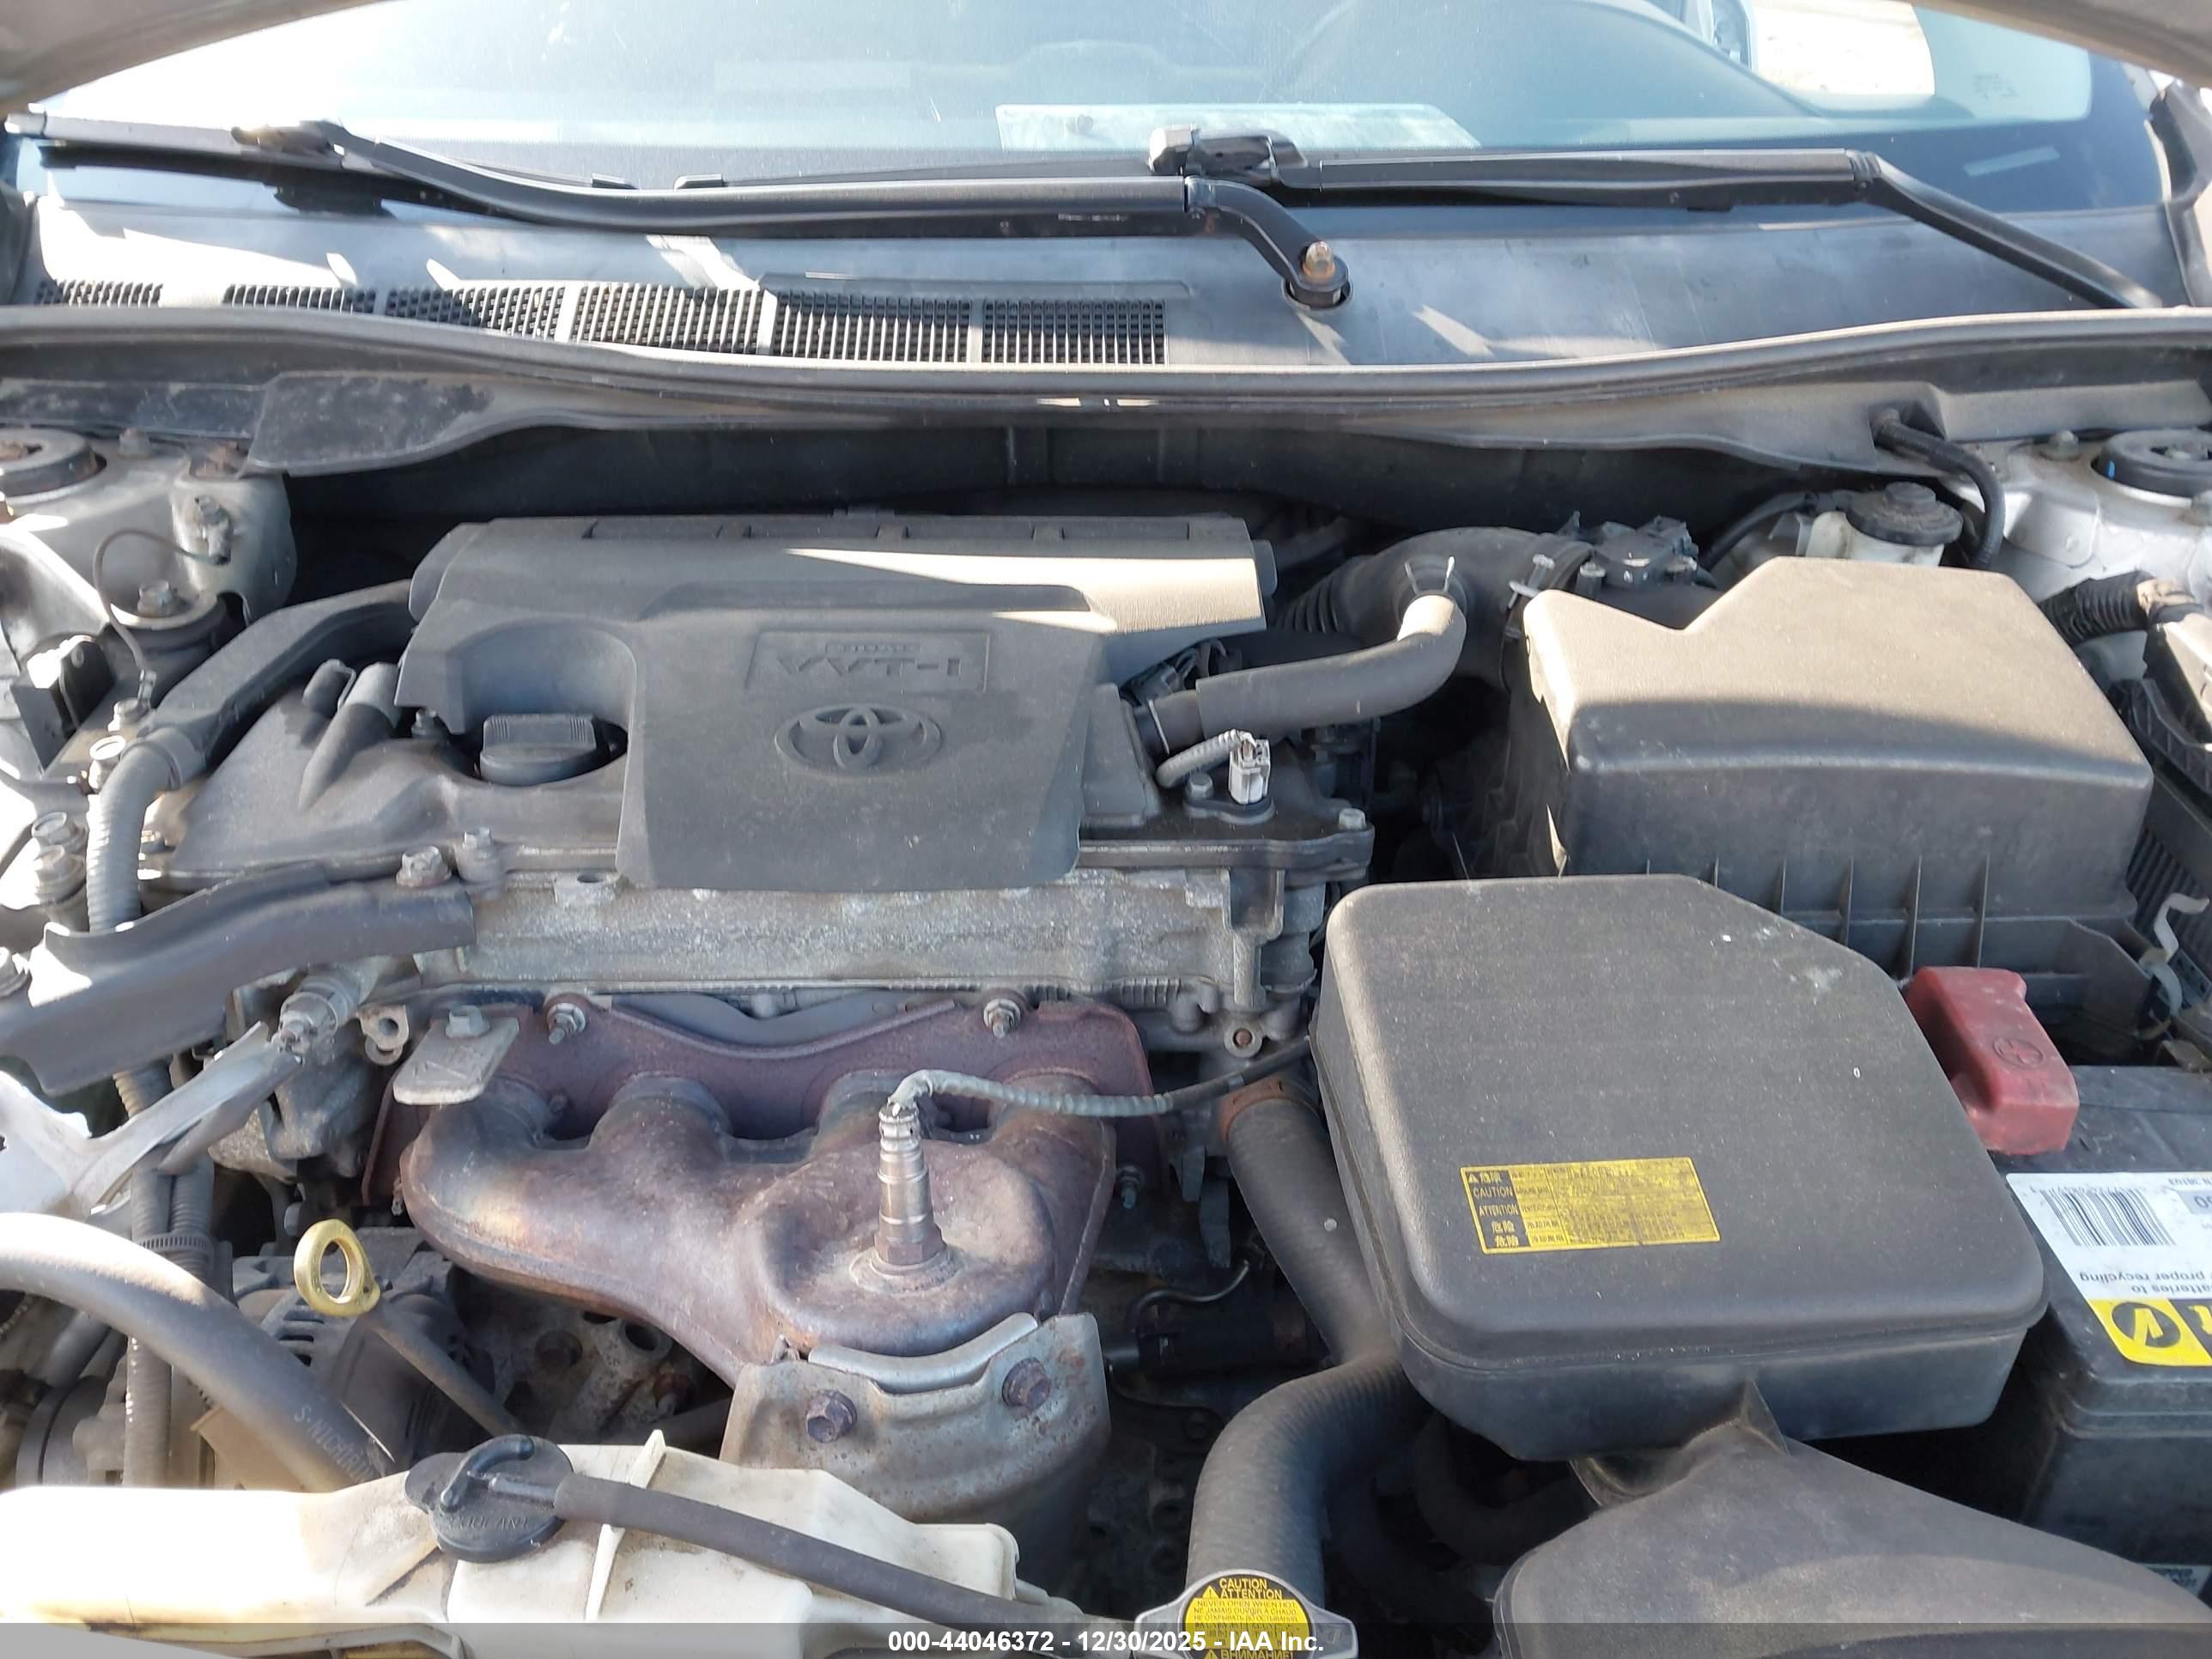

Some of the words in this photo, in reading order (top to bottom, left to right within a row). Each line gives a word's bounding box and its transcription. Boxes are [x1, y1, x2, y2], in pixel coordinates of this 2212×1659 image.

[1473, 1186, 1513, 1199] CAUTION
[1479, 1203, 1519, 1217] ATTENTION
[2080, 1270, 2149, 1284] recycling
[2156, 1270, 2205, 1282] proper
[2131, 1285, 2150, 1294] to
[1219, 1577, 1267, 1589] CAUTION
[1220, 1589, 1283, 1600] ATTENTION
[1226, 1600, 1251, 1608] OPEN
[1252, 1600, 1278, 1609] WHEN
[1279, 1601, 1297, 1609] HOT
